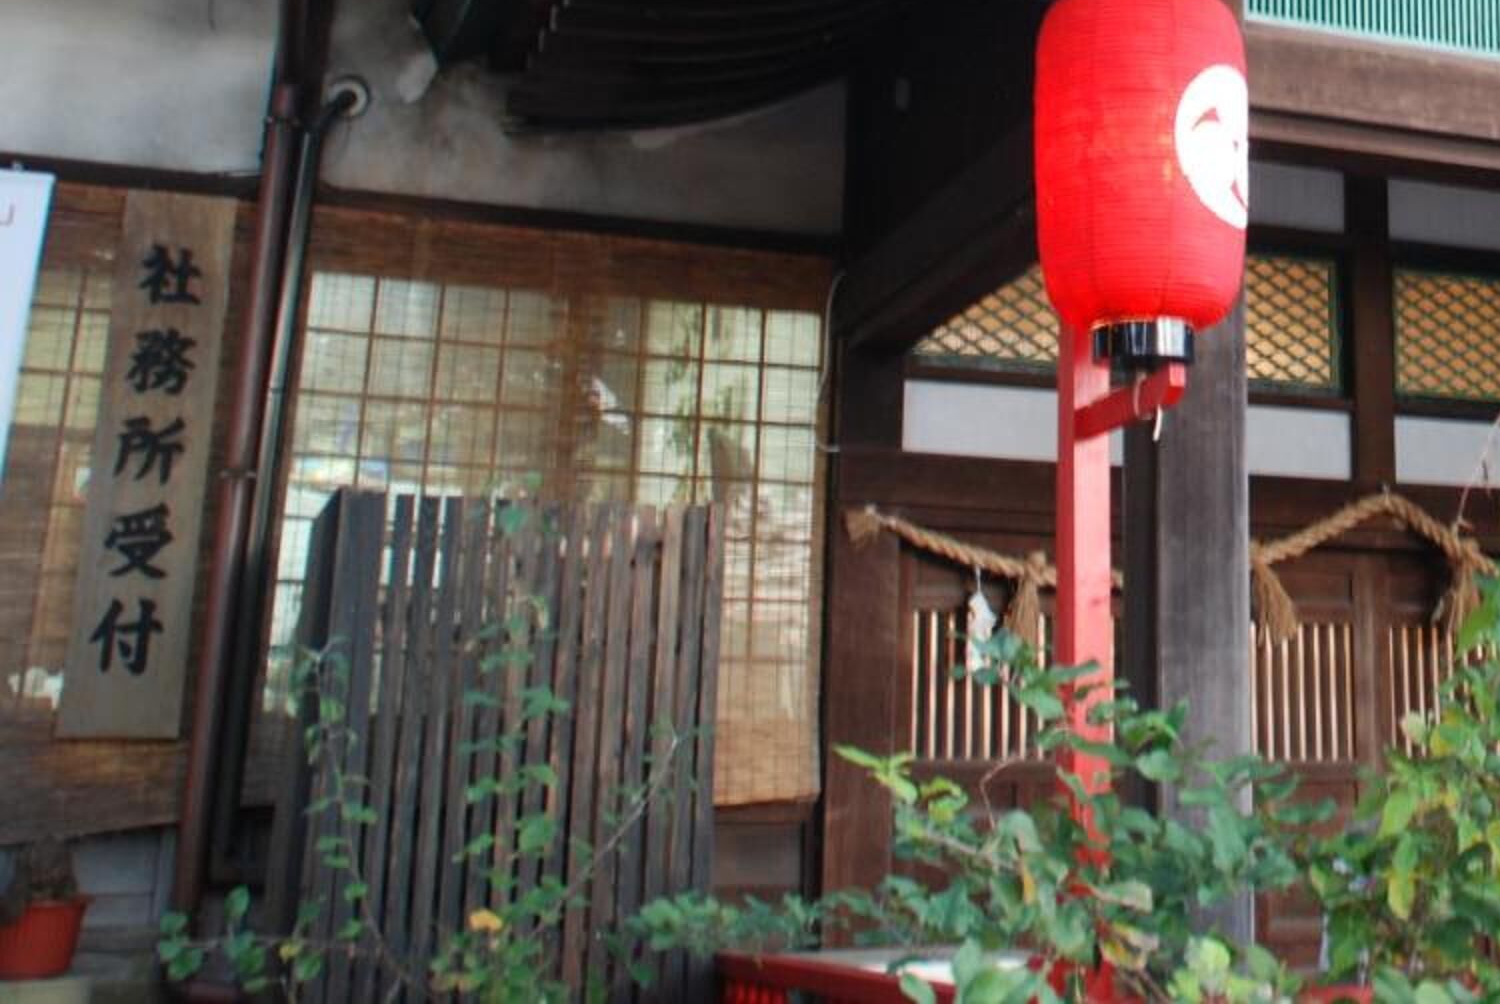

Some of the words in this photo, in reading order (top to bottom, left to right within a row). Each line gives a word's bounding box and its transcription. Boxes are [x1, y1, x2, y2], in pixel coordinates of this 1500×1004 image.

[90, 244, 203, 675] 社務所受付
